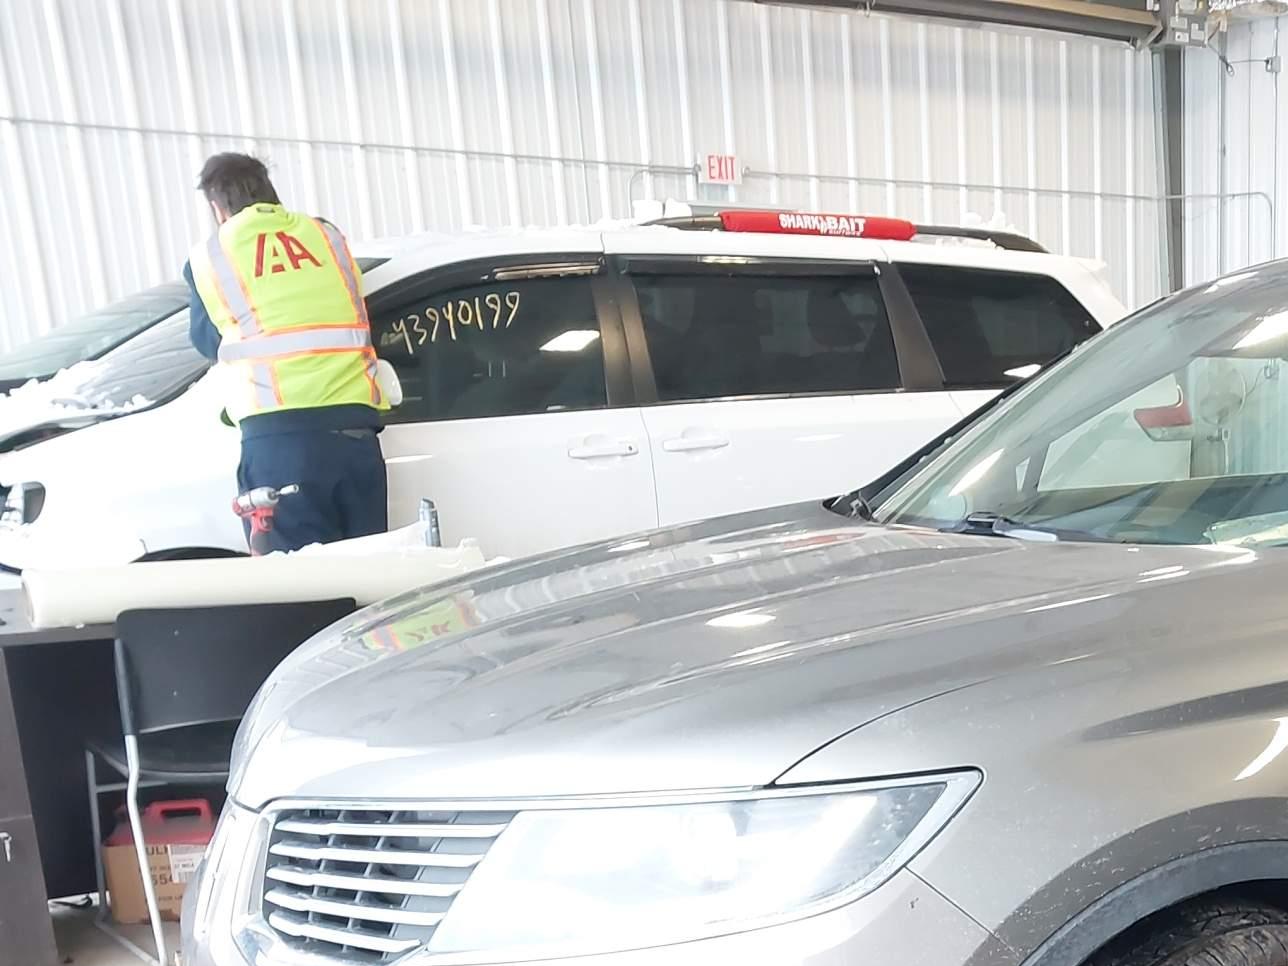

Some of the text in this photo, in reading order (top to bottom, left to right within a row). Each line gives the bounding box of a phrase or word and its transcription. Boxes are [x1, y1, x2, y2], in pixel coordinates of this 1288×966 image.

[708, 154, 735, 181] EXIT
[779, 213, 866, 234] SHARK BAIT
[392, 291, 520, 355] 43940199
